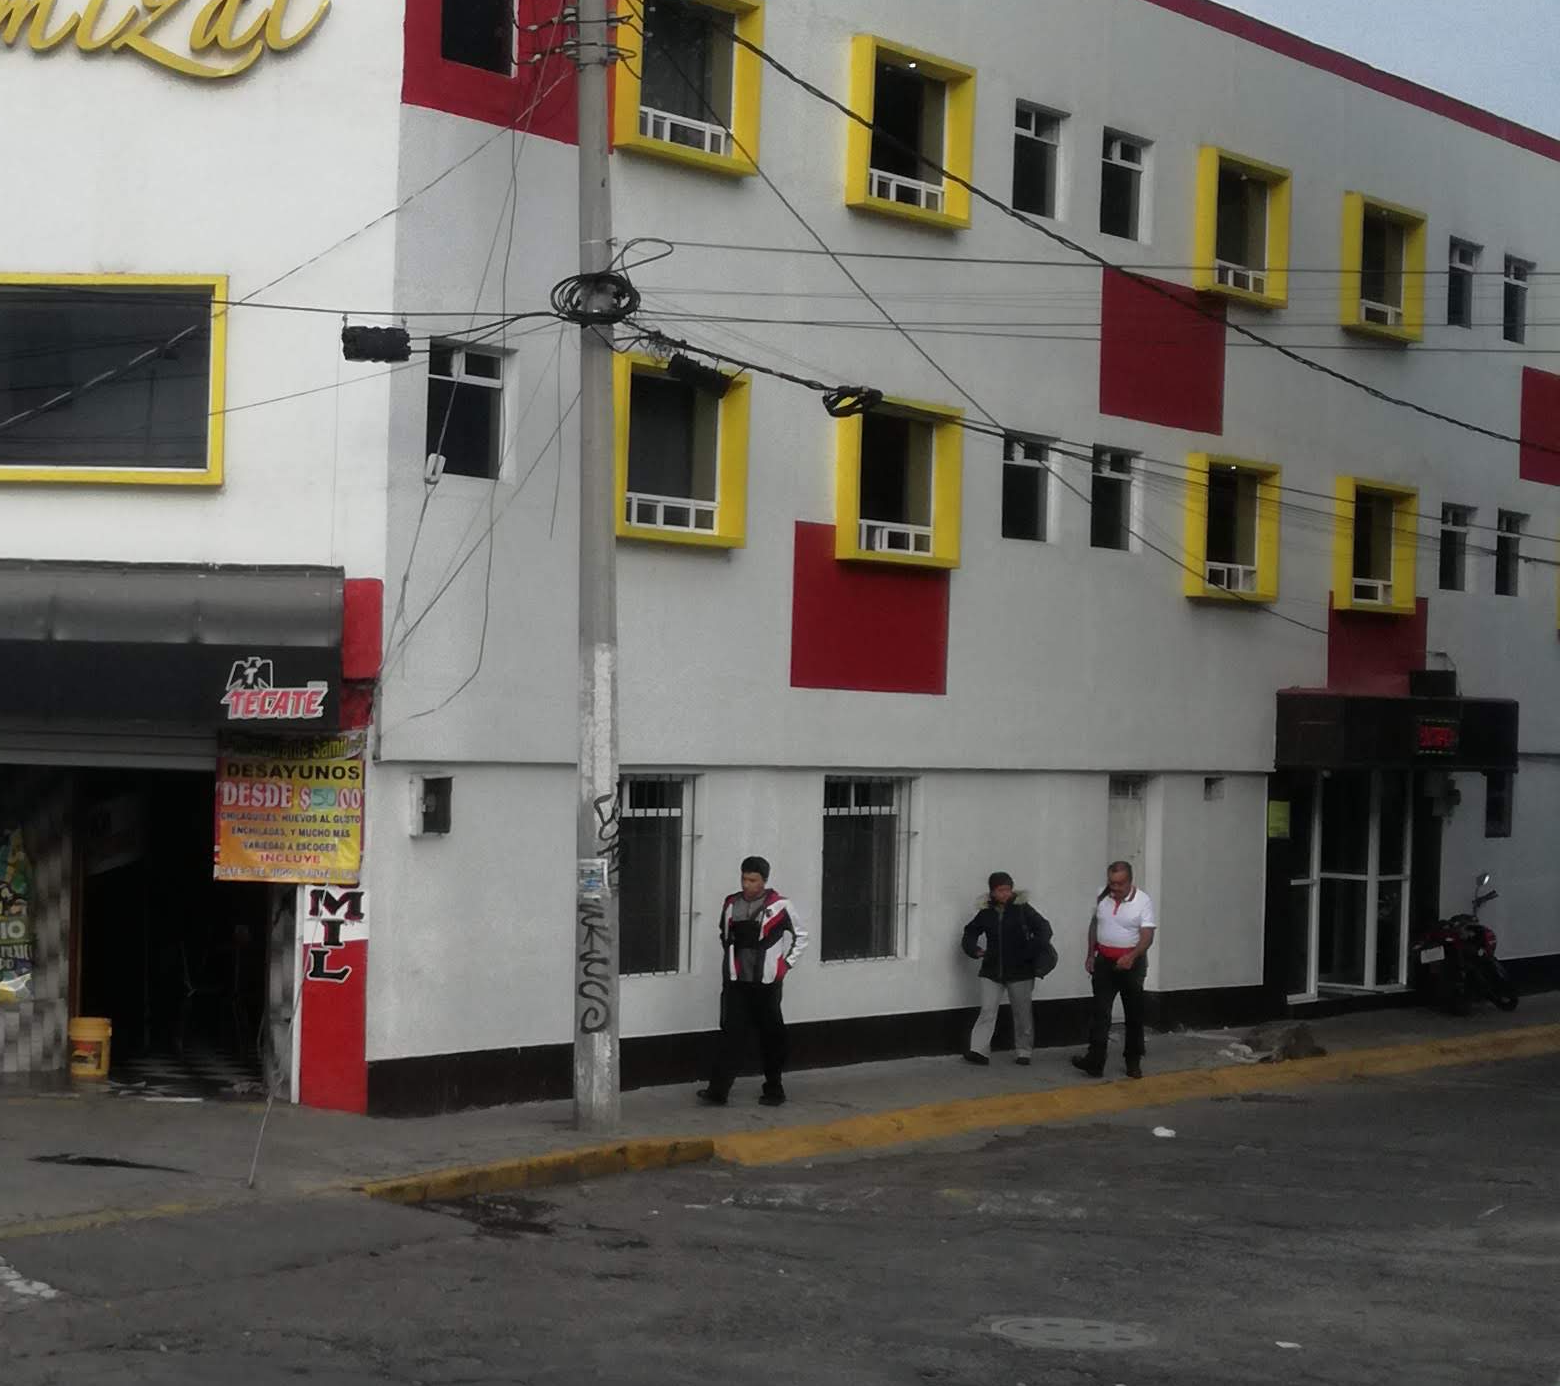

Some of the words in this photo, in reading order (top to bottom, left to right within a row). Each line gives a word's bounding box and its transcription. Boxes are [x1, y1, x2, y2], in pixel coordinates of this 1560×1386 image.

[228, 689, 326, 718] TECATE
[226, 761, 361, 781] DESAYUNOS
[222, 781, 293, 808] DESDE
[281, 813, 317, 823] HUEVOS
[319, 813, 331, 823] AL
[332, 813, 361, 824] GUSTO
[289, 828, 297, 837] Y
[298, 827, 331, 838] MUCHO
[242, 840, 283, 851] VARIEDAD
[259, 854, 321, 864] INCLUYE
